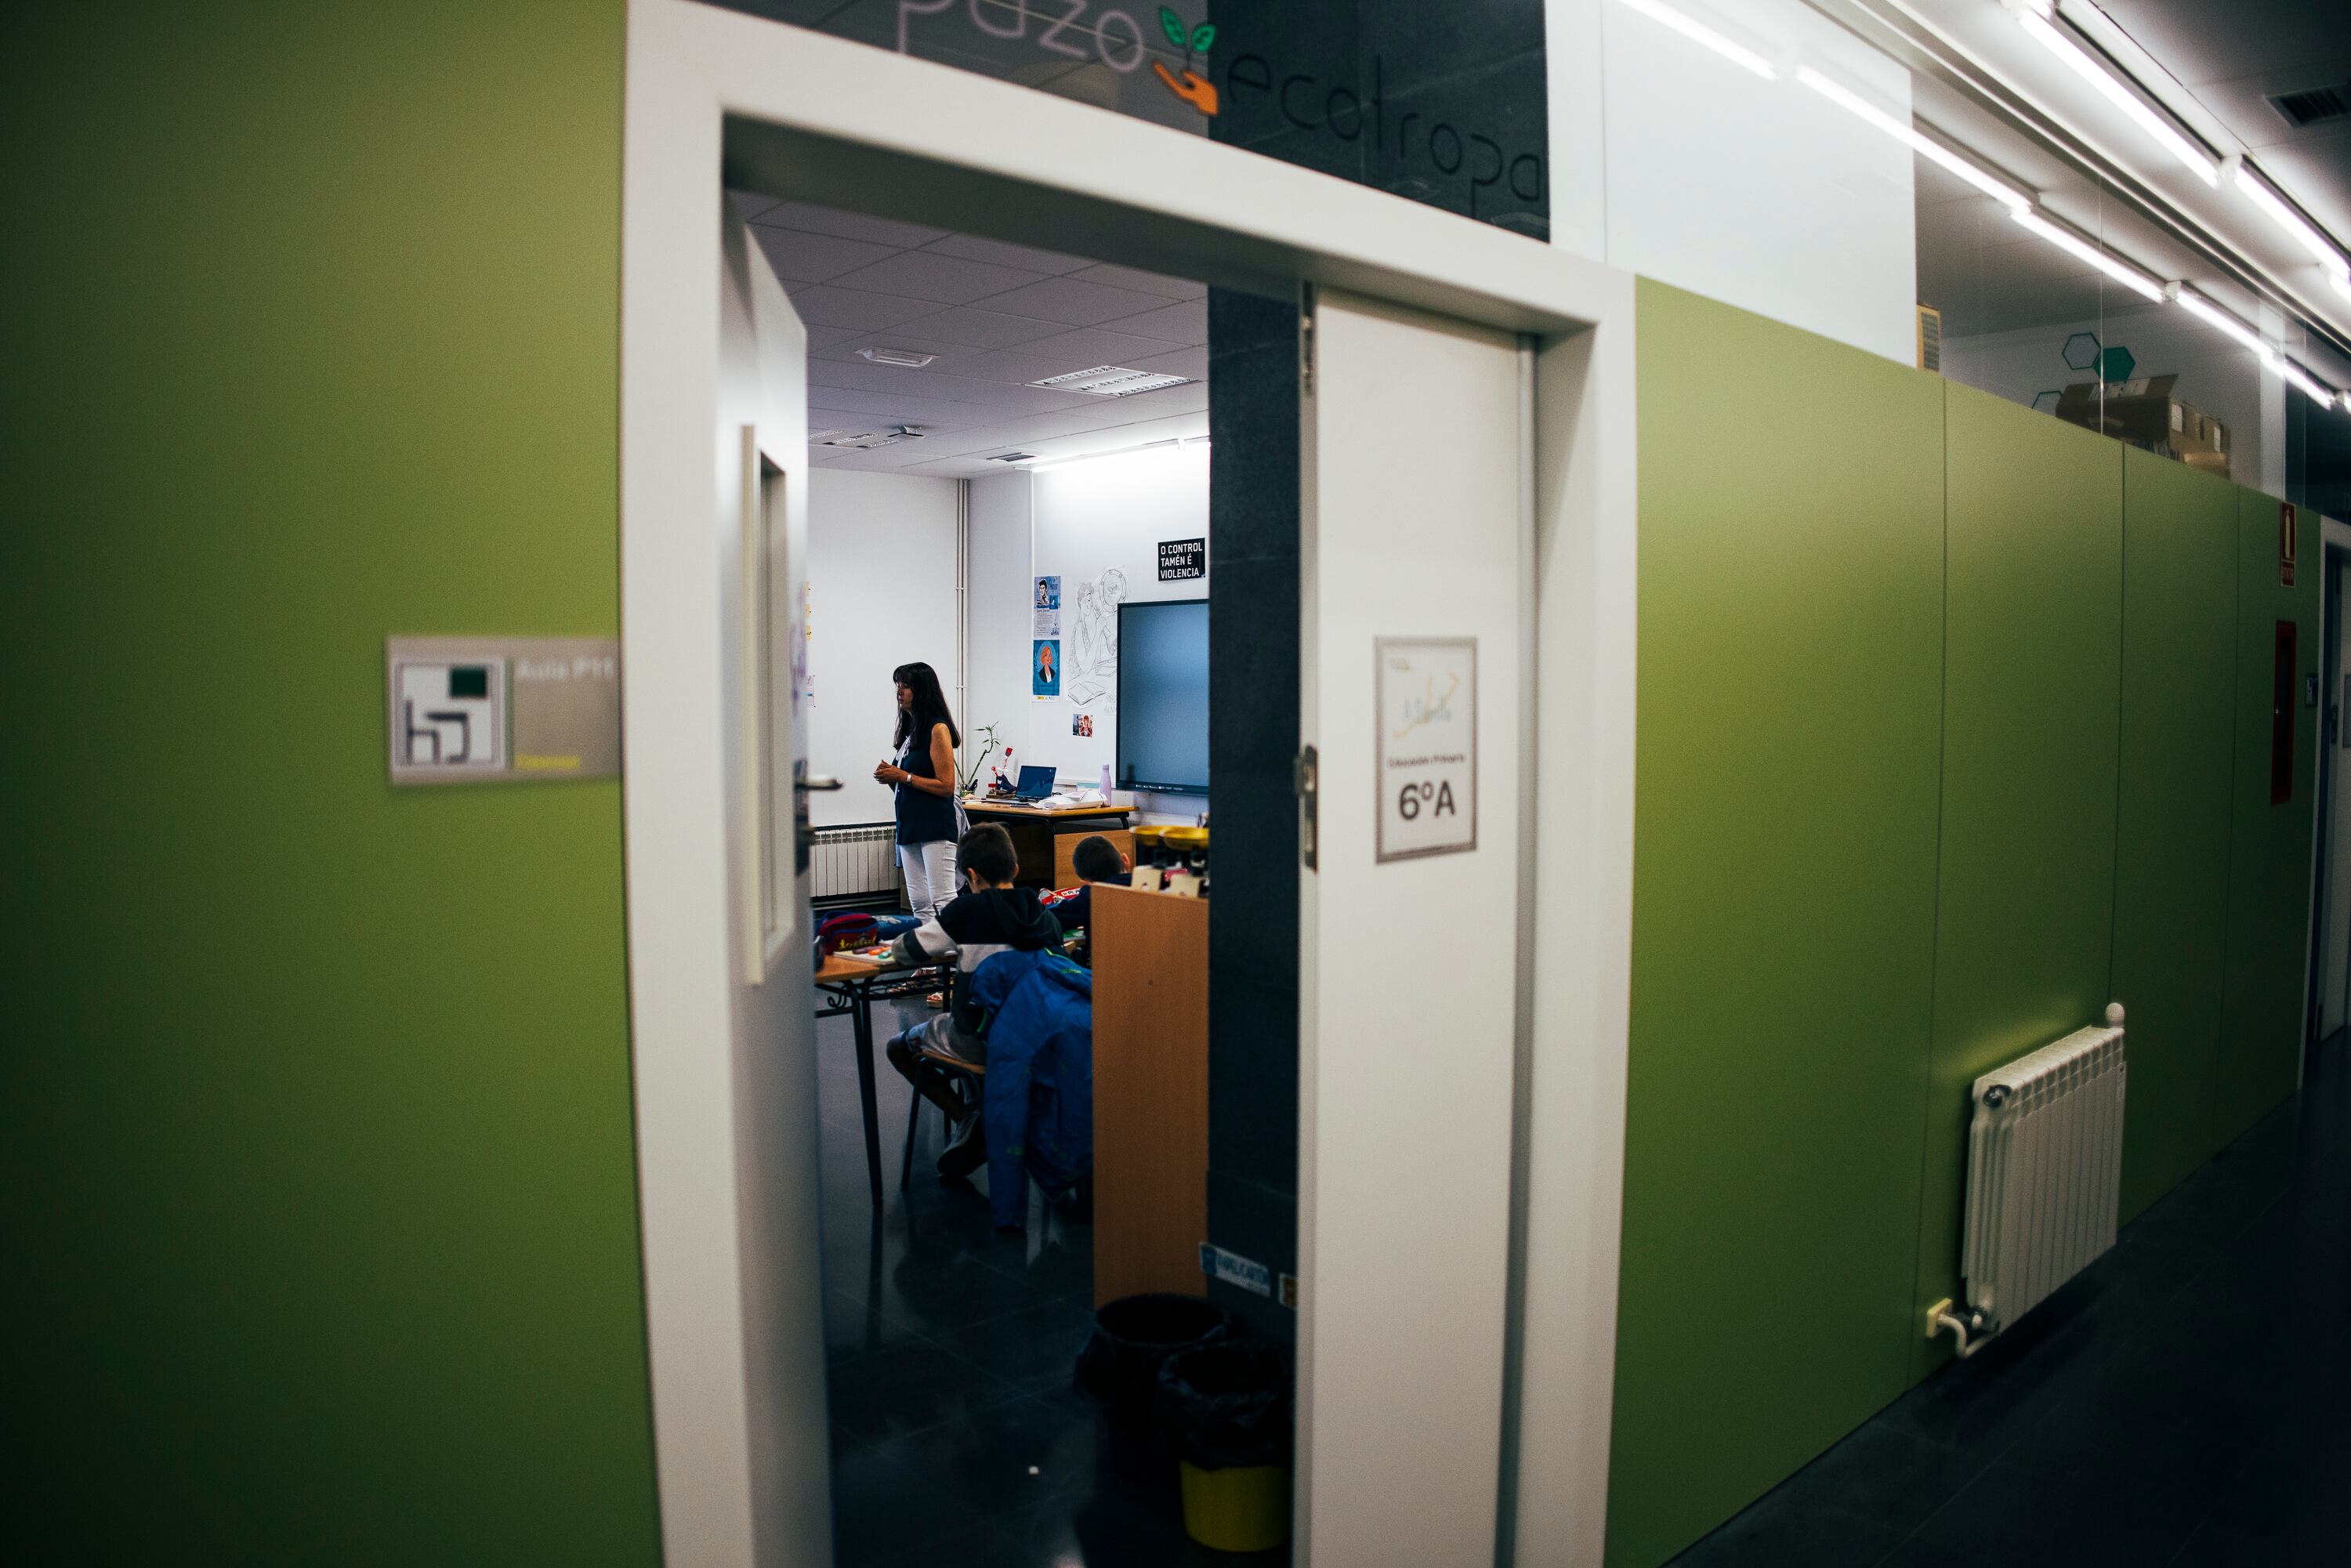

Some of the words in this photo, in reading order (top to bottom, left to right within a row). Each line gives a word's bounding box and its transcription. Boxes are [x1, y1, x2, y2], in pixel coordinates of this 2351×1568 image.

[1161, 545, 1166, 555] O
[1168, 542, 1203, 554] CONTROL
[1161, 554, 1185, 567] TAMÉN
[1187, 552, 1192, 565] É
[1161, 567, 1199, 578] VIOLENCIA
